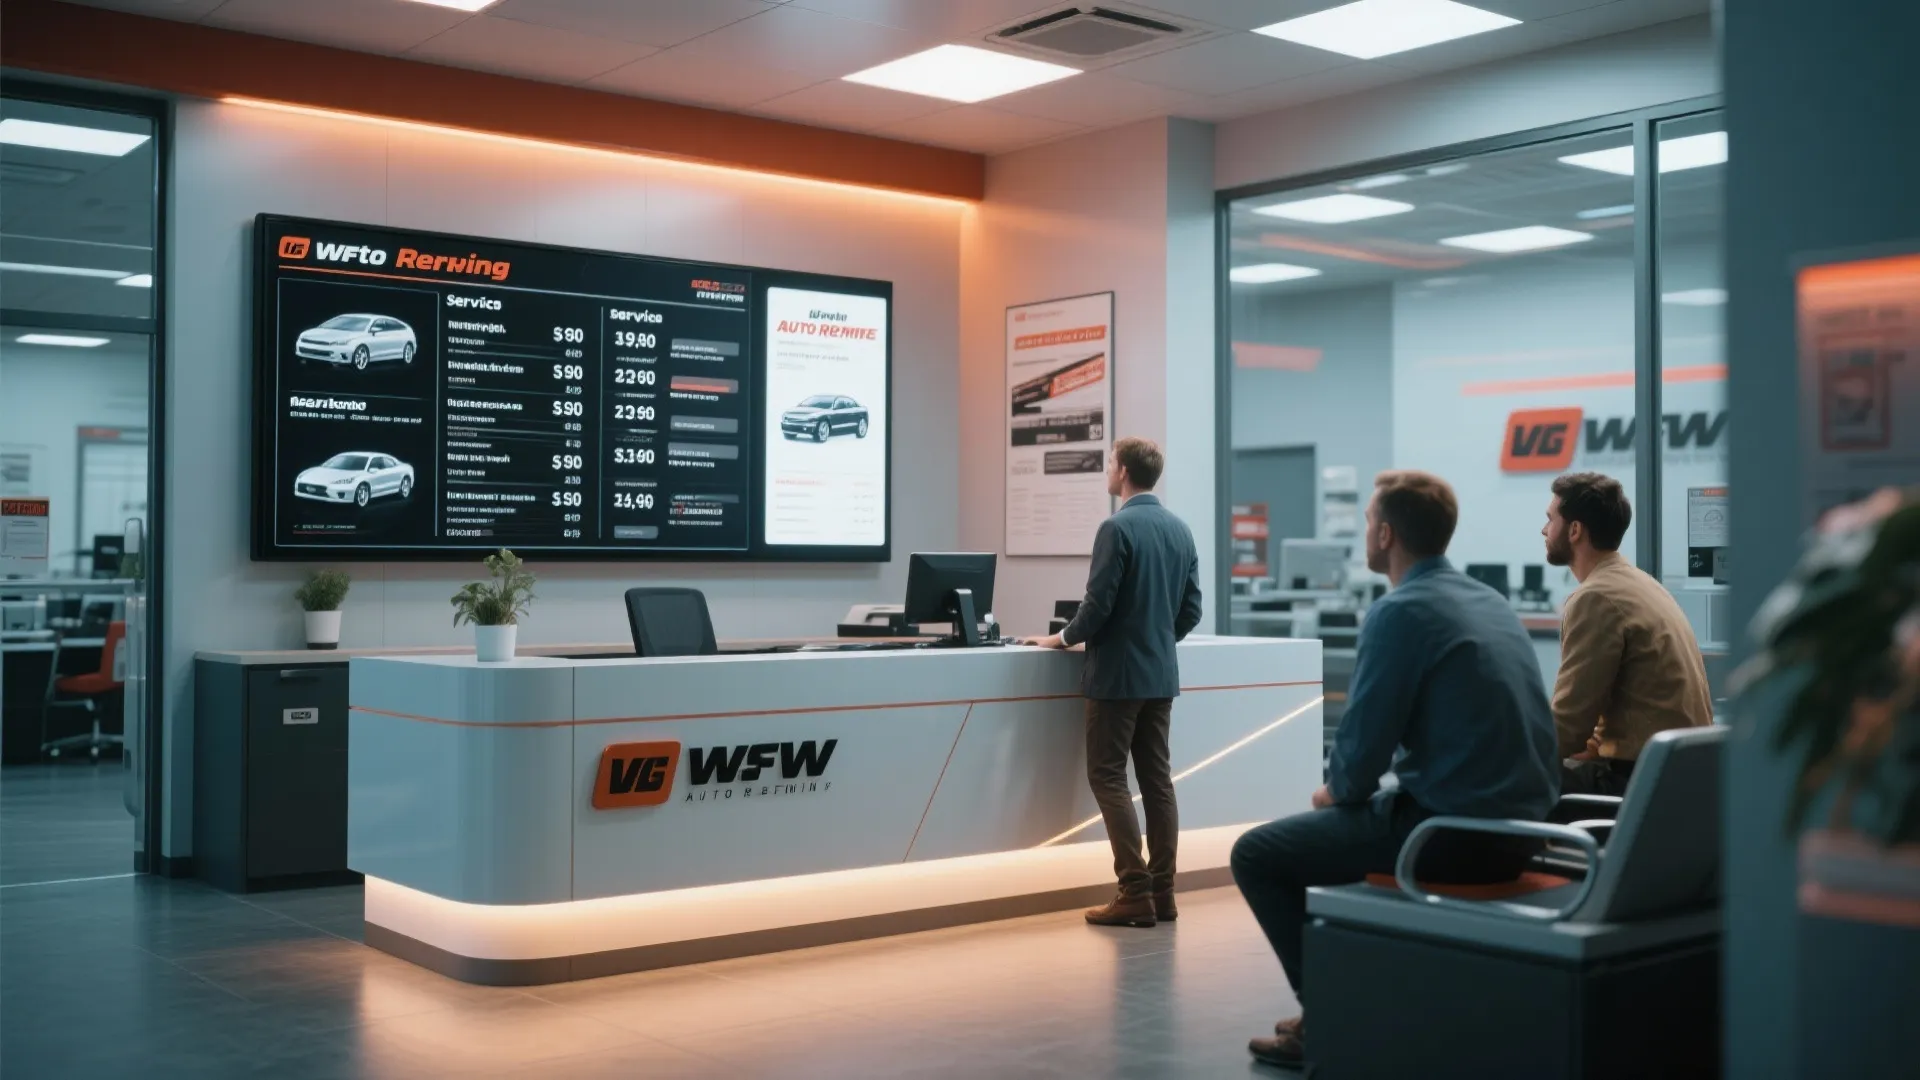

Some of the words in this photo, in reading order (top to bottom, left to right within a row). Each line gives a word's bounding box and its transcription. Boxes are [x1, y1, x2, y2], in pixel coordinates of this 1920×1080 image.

[316, 242, 387, 265] WFto
[1511, 424, 1567, 457] VG
[609, 757, 669, 795] VG
